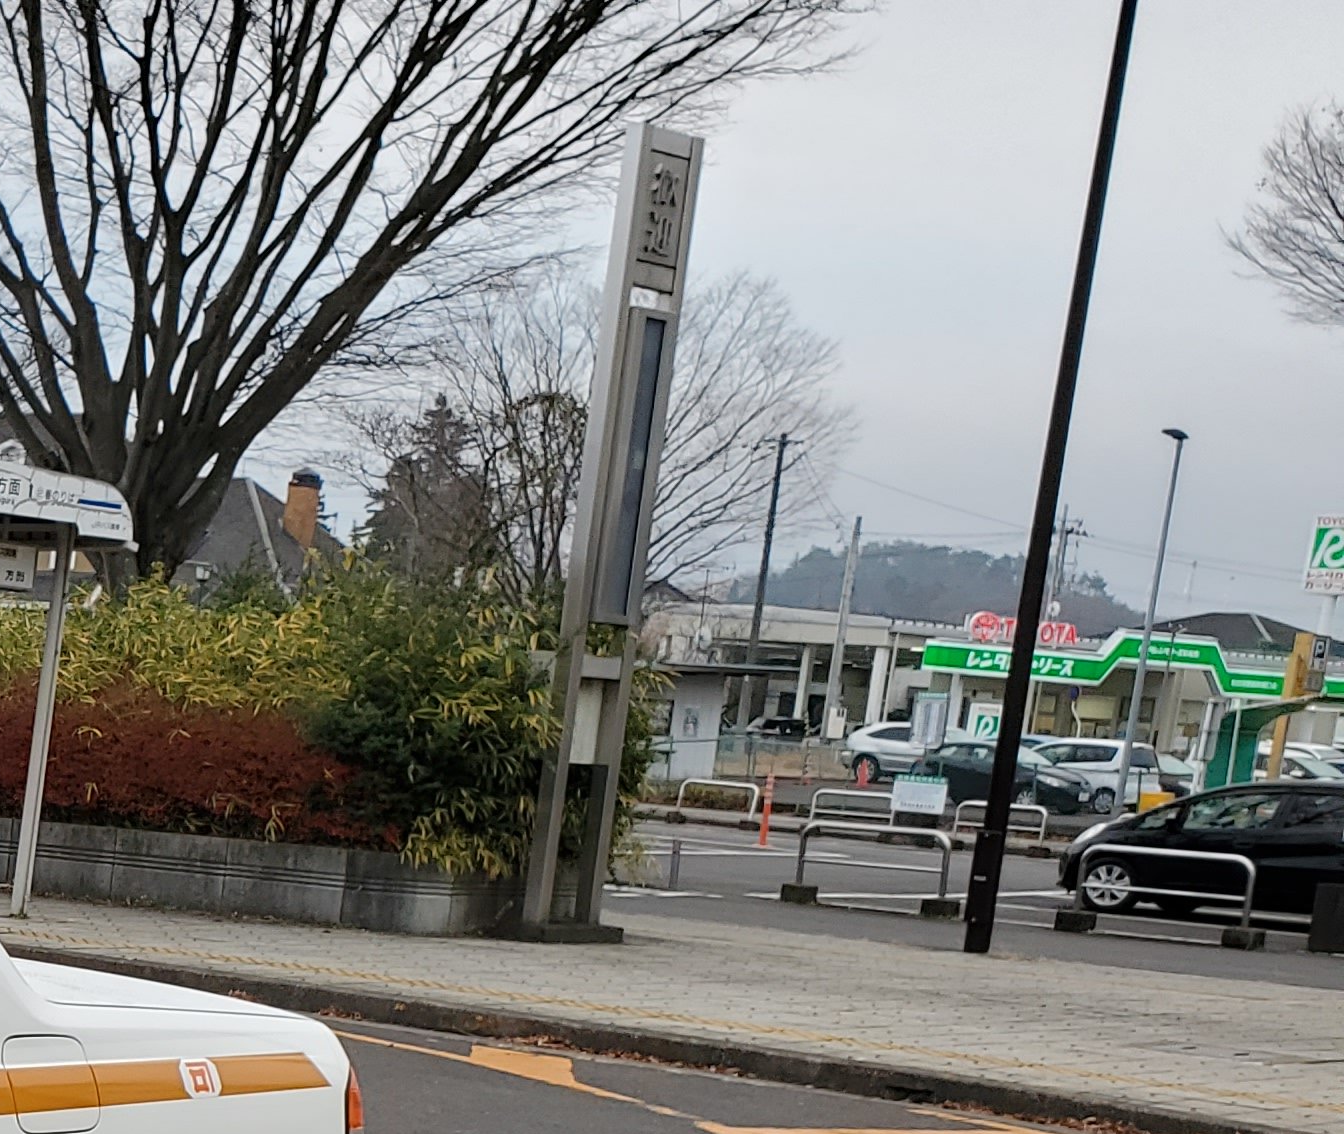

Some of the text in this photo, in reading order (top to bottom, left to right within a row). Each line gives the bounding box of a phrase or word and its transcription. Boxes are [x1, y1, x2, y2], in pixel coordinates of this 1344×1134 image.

[1003, 617, 1078, 646] TOTA
[965, 651, 1075, 677] レンタリース
